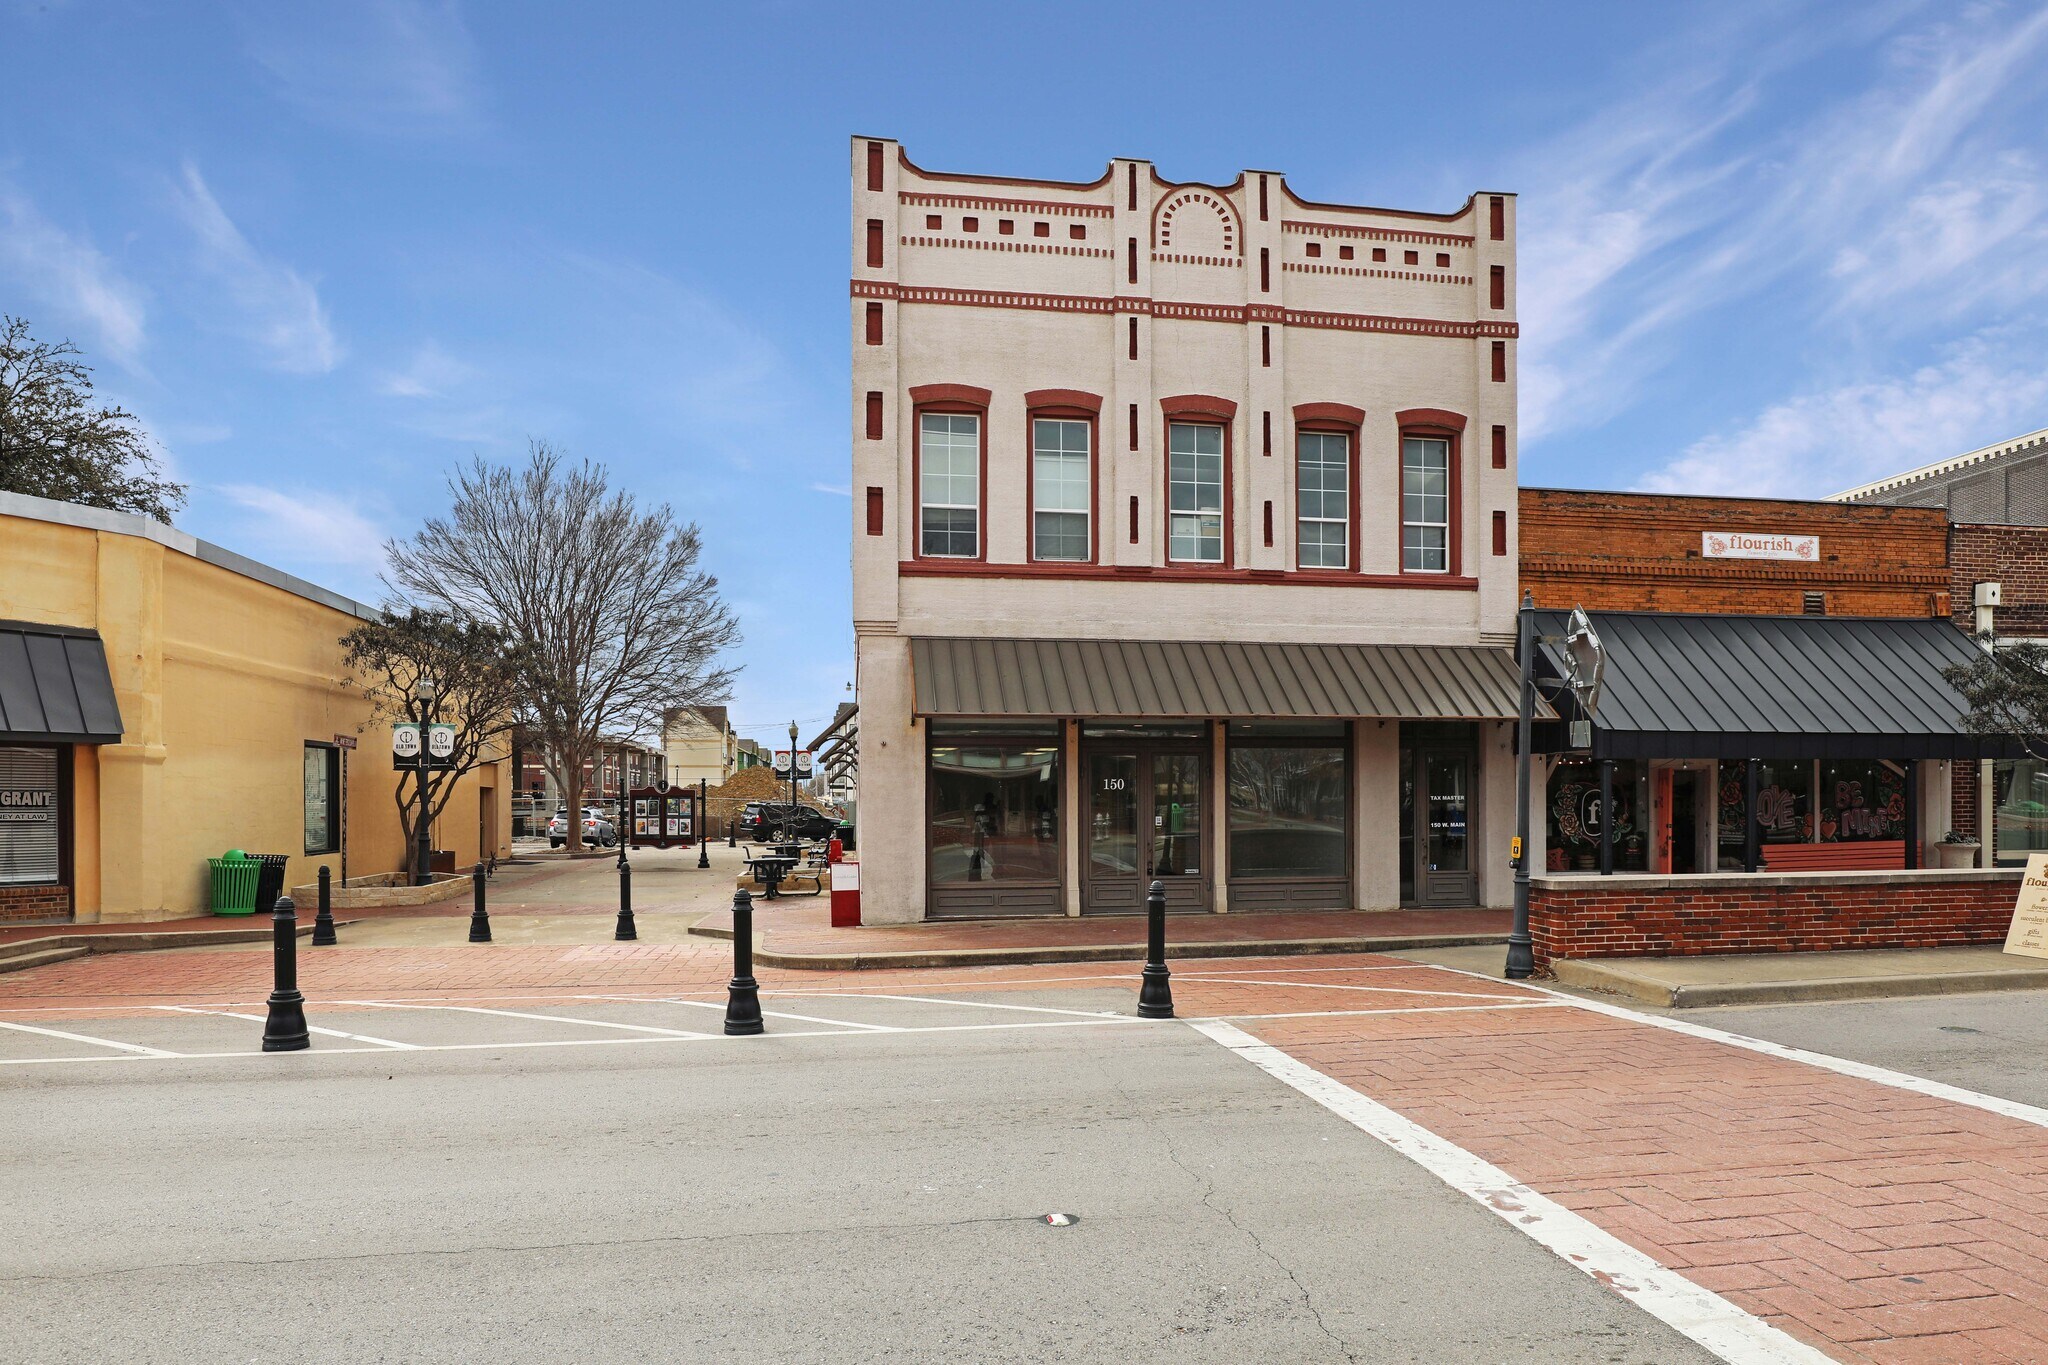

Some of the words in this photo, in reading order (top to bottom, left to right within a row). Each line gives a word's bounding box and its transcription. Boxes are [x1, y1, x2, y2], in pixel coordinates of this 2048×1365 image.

[1729, 535, 1793, 551] flourish
[1103, 779, 1125, 790] 150
[1, 791, 52, 806] GRANT
[1835, 780, 1864, 808] BE
[1841, 808, 1888, 838] MINE
